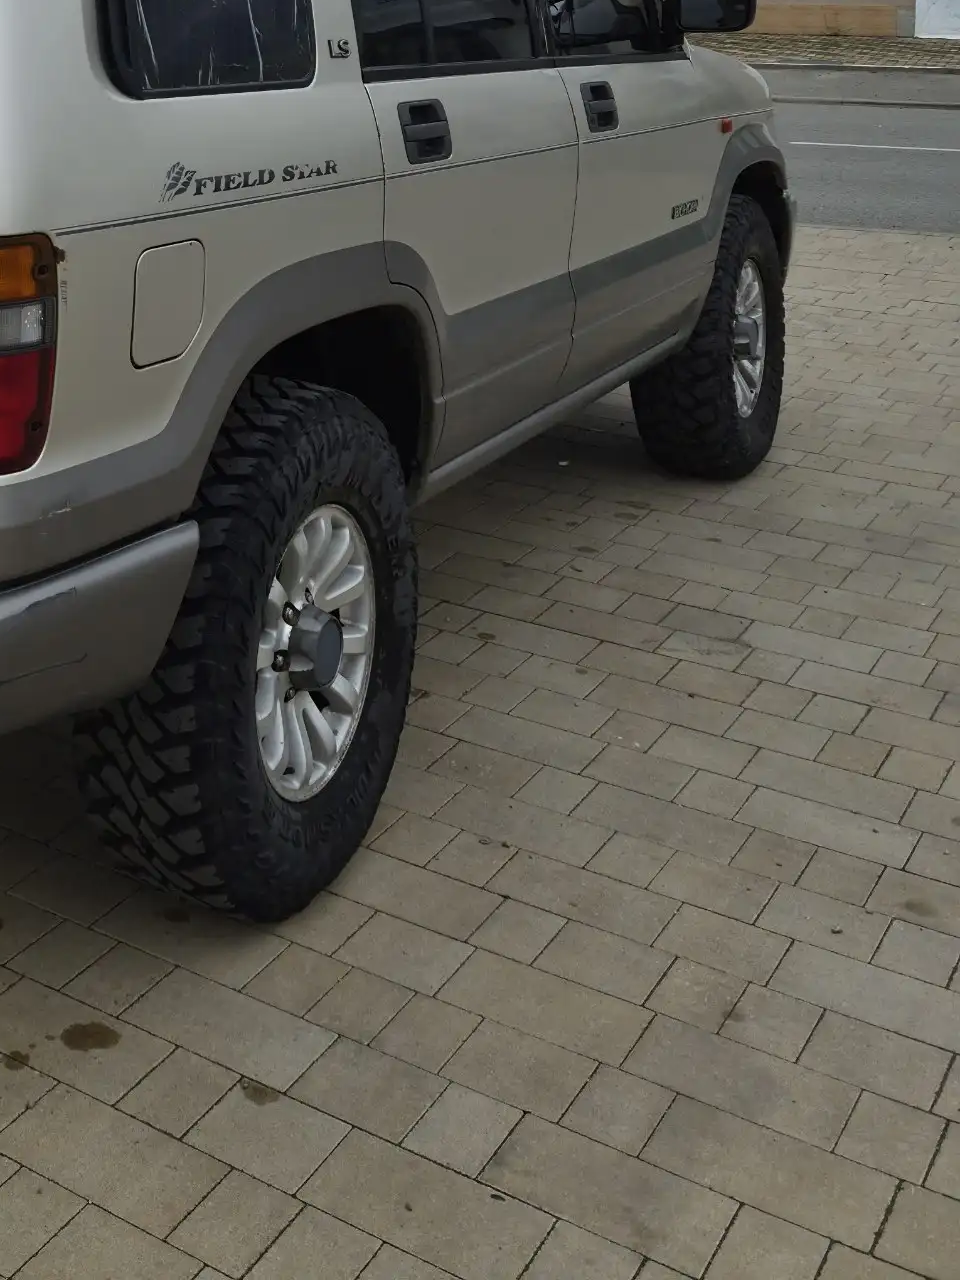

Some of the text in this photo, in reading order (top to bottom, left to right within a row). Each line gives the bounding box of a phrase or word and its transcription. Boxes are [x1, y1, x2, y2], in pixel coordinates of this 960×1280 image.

[327, 38, 351, 59] LS
[193, 159, 338, 197] FIELD STAR
